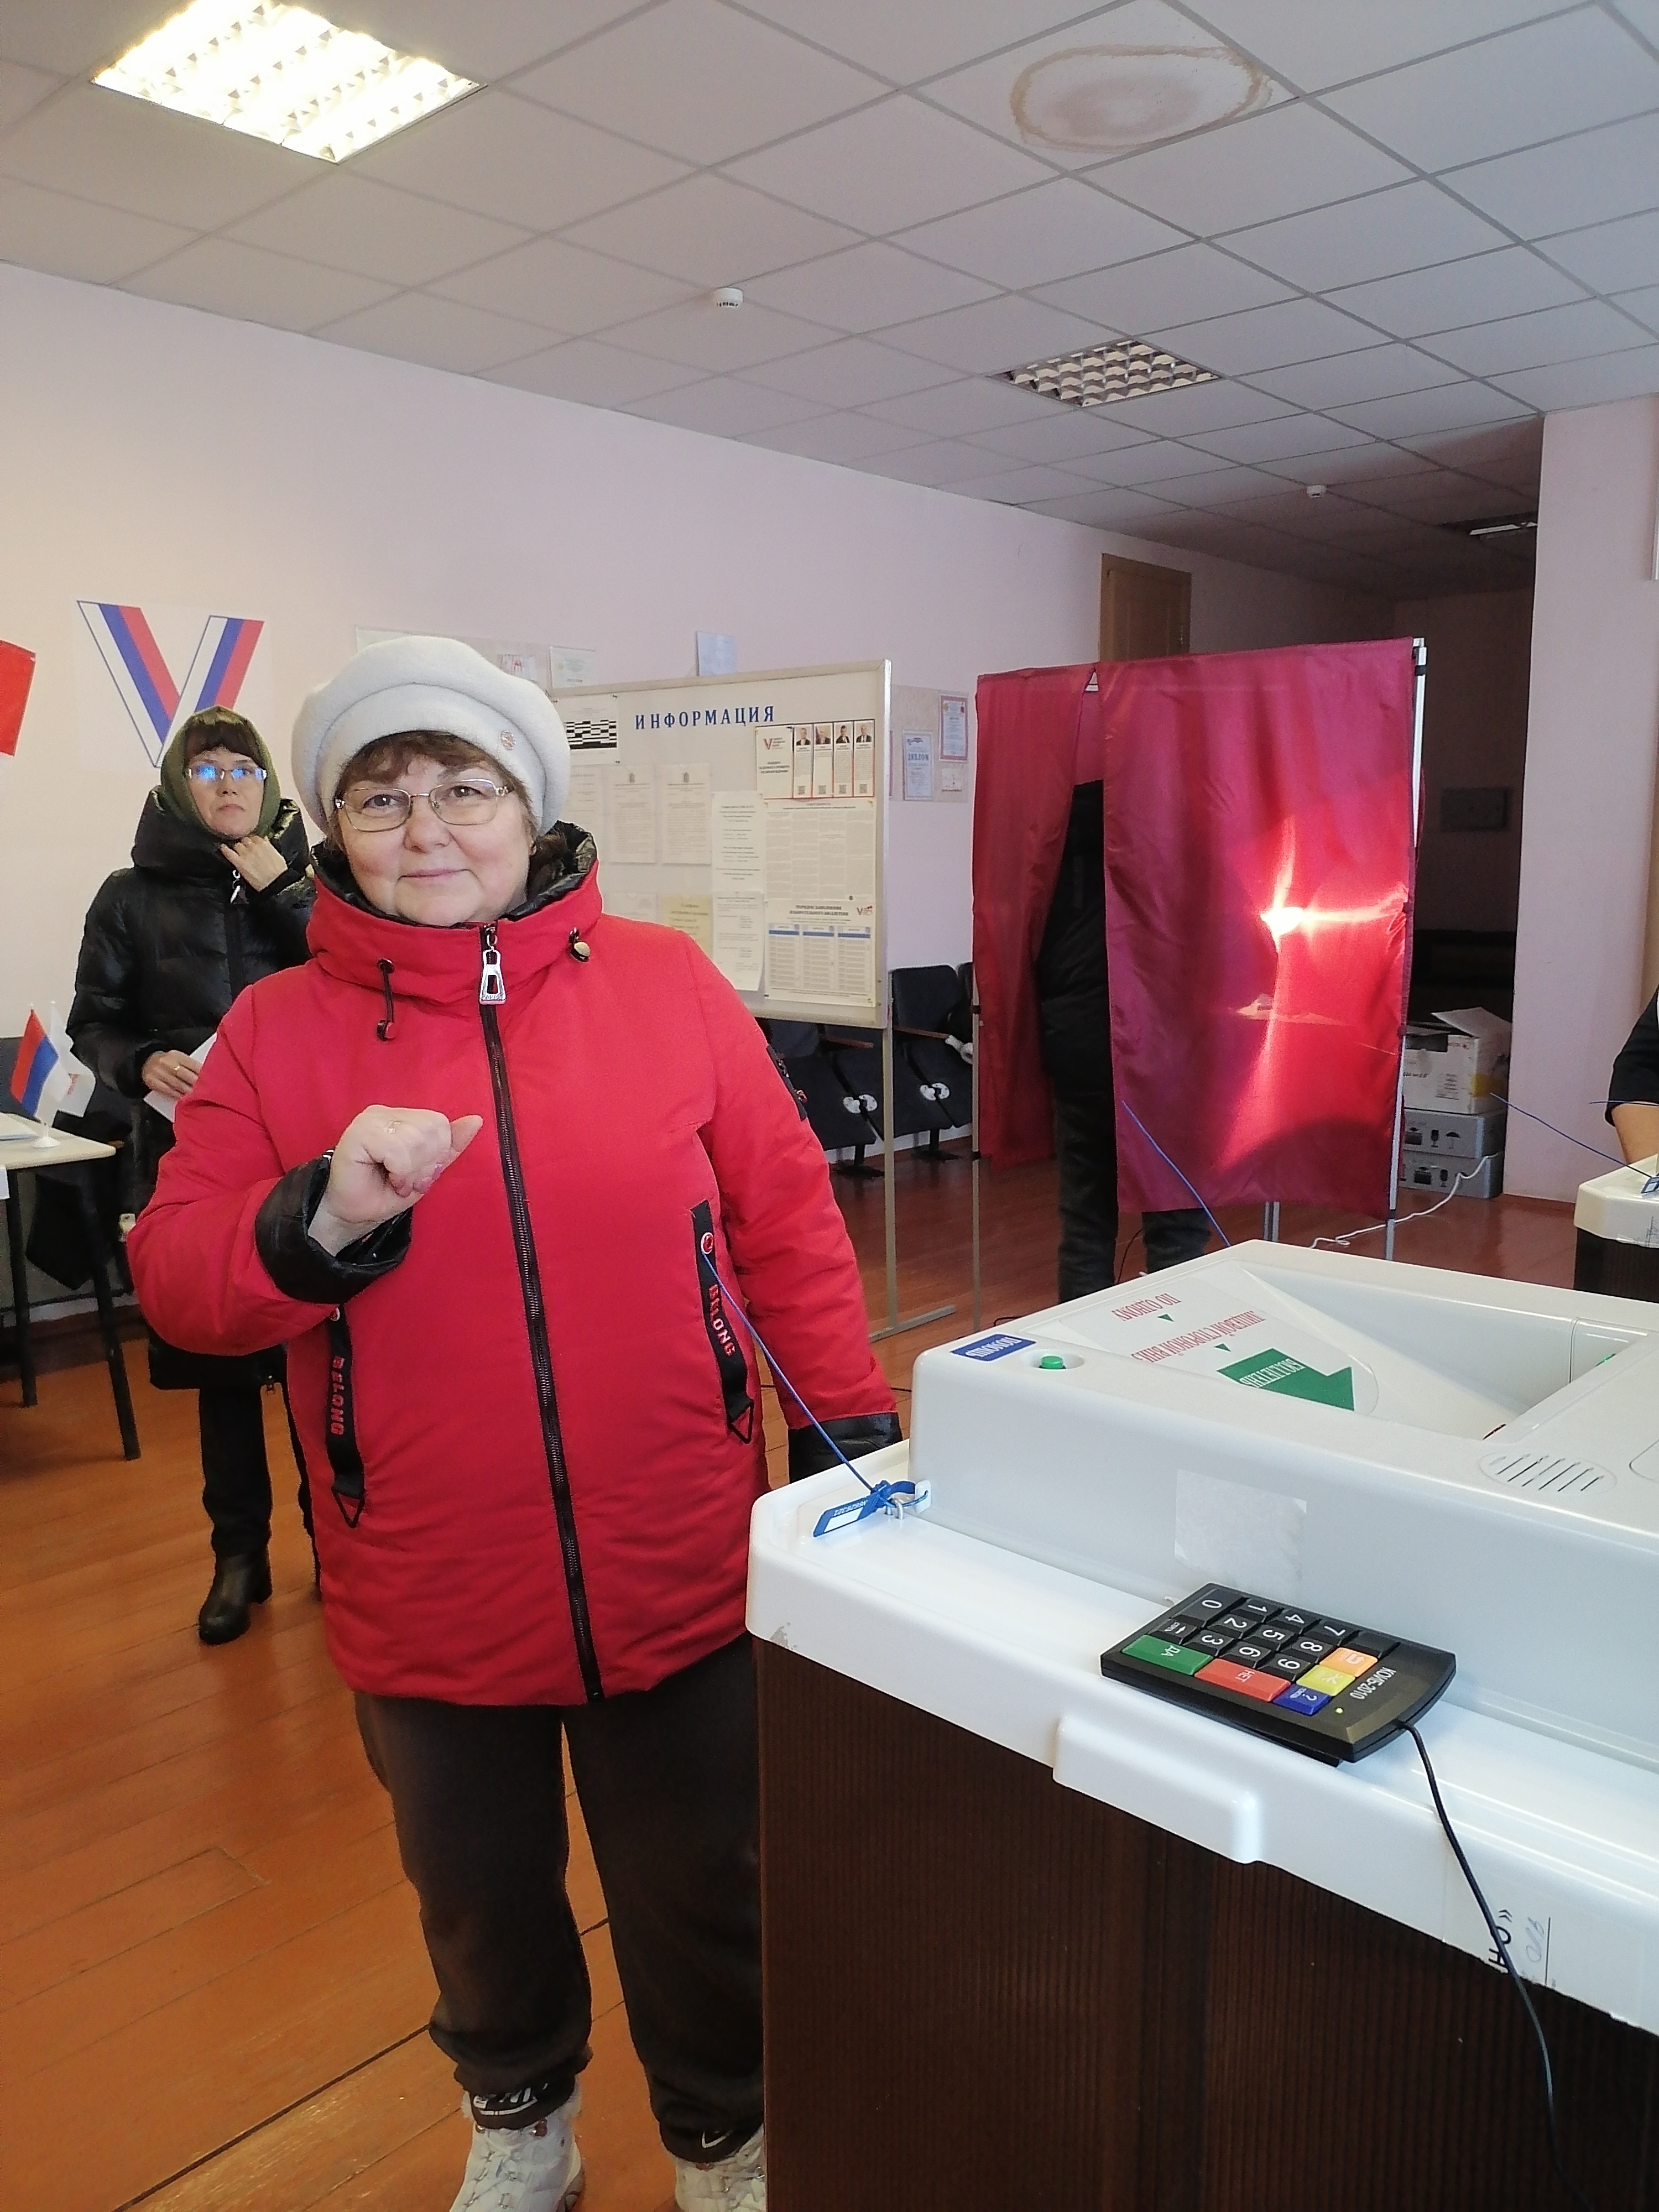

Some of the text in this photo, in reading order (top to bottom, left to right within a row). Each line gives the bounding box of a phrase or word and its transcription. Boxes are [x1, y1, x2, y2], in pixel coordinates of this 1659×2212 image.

[635, 705, 775, 730] ИНФОРМАЦИЯ
[1112, 1293, 1182, 1321] ПО ОДНОМУ
[708, 1284, 735, 1357] BELONG
[1209, 1310, 1266, 1337] ЛИЦЕВОЙ
[965, 1336, 1022, 1358] ПОМОЩЬ
[1159, 1327, 1222, 1357] СТОРОНОЙ
[1239, 1358, 1306, 1389] БЮЛЛЕТЕНЬ
[330, 1355, 345, 1436] BELONG
[1201, 1599, 1223, 1609] 0
[1248, 1604, 1267, 1613] 1
[1224, 1617, 1248, 1628] 2
[1285, 1614, 1305, 1624] 4
[1262, 1629, 1286, 1641] 5
[1324, 1625, 1346, 1636] 7
[1201, 1634, 1224, 1645] 3
[1161, 1645, 1182, 1657] ДА
[1239, 1646, 1261, 1657] 6
[1300, 1641, 1323, 1652] 8
[1277, 1658, 1300, 1670] 9
[1234, 1669, 1256, 1683] НЕТ
[1349, 1667, 1396, 1700] КОИБ-2010
